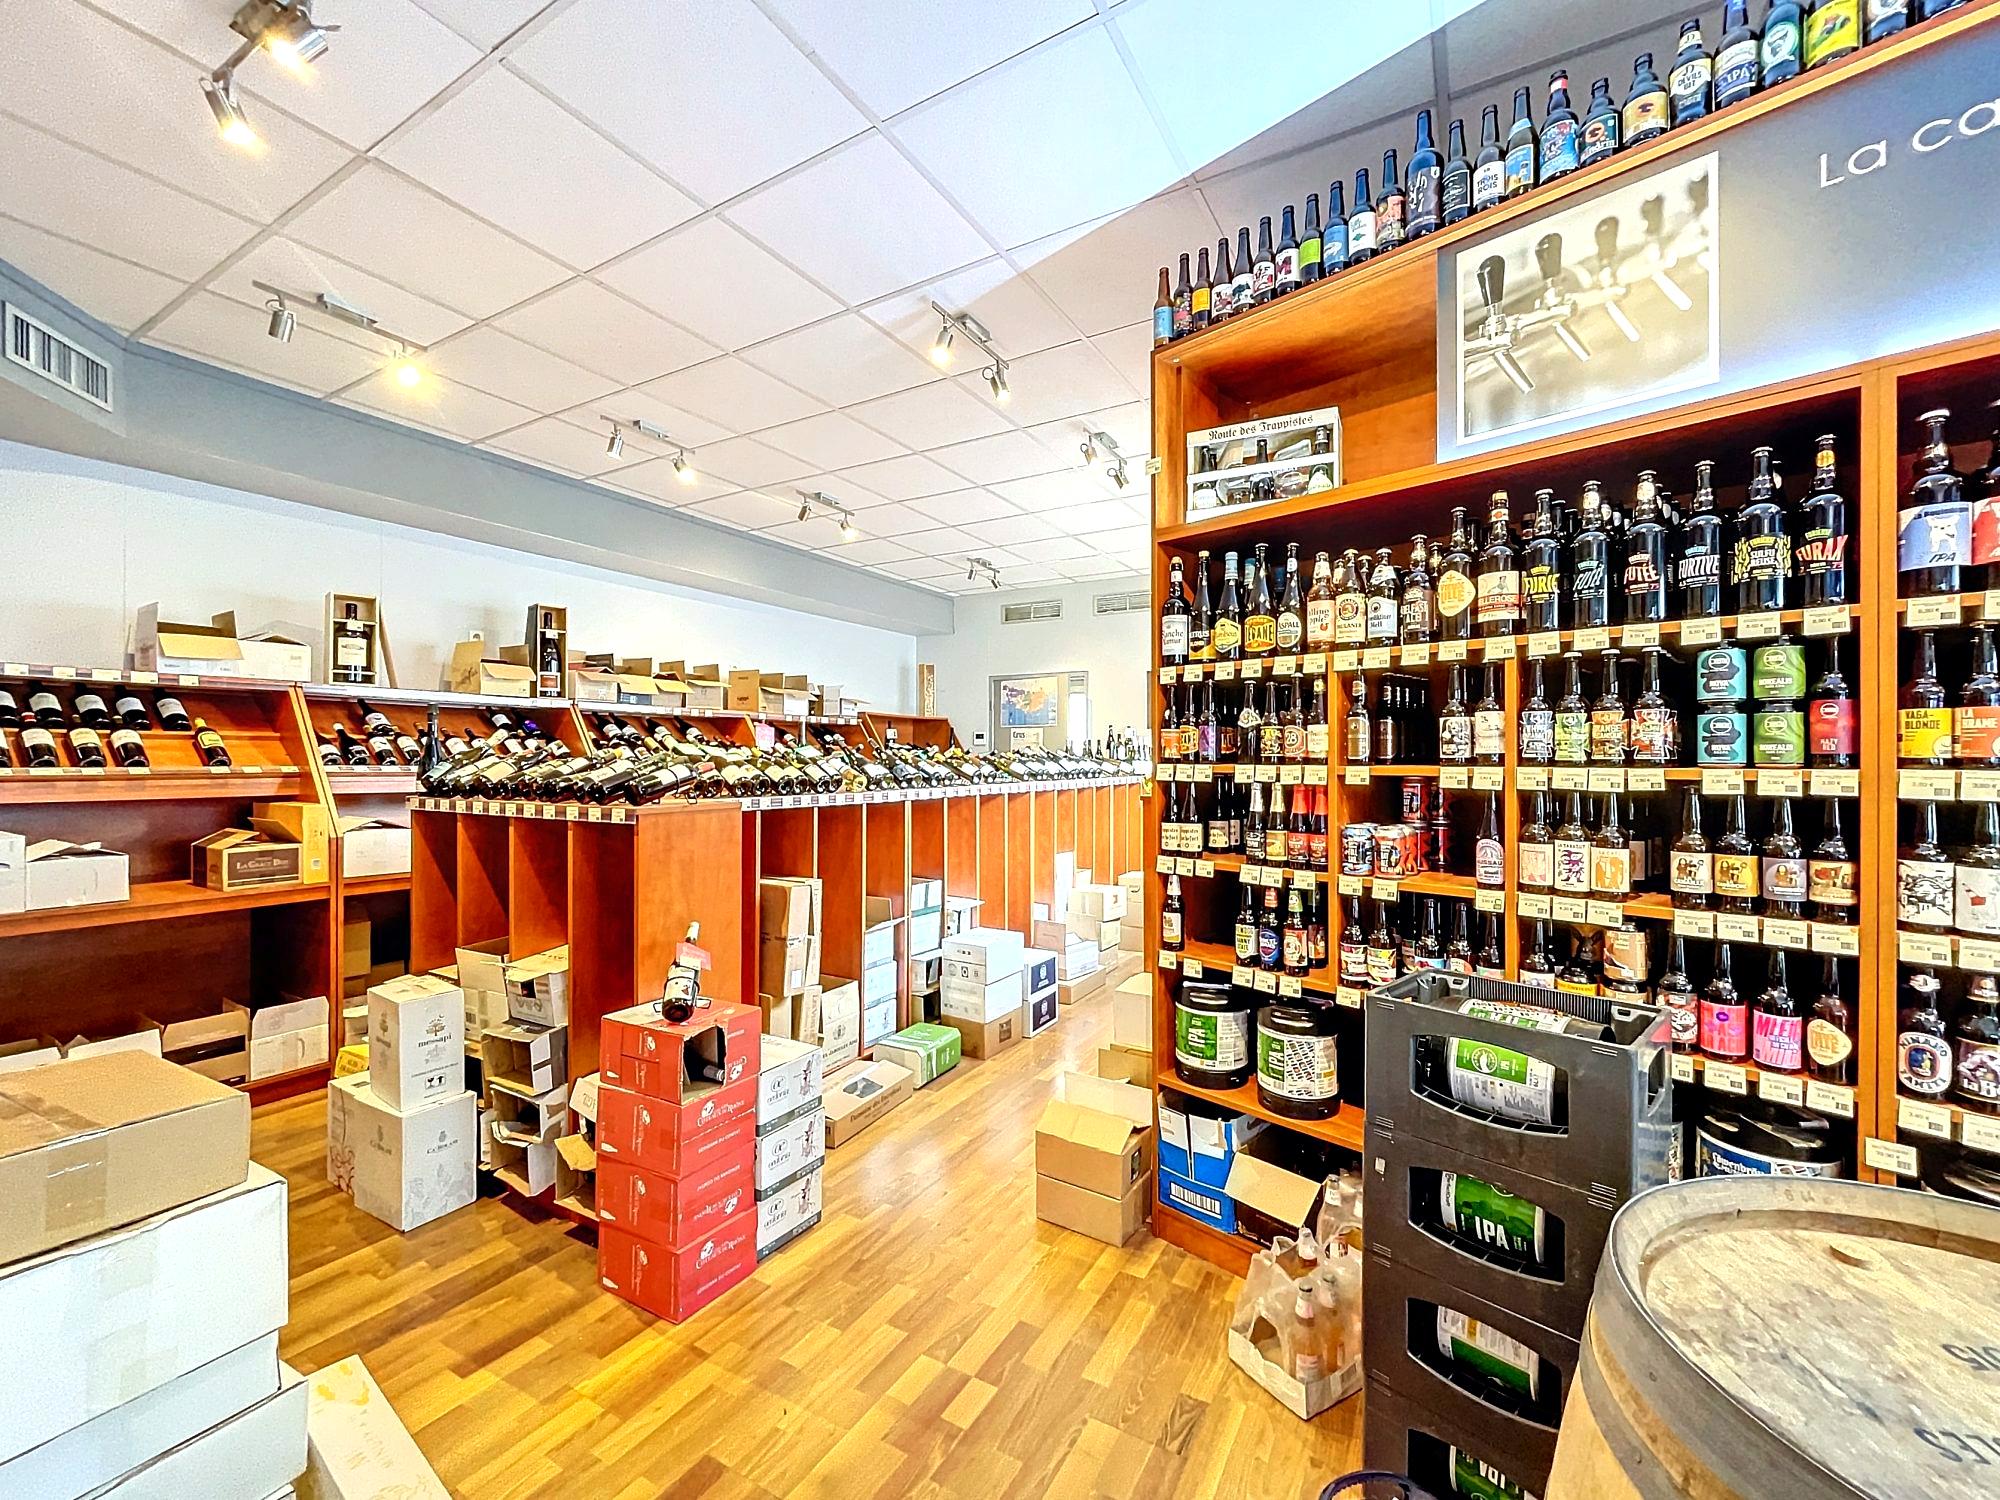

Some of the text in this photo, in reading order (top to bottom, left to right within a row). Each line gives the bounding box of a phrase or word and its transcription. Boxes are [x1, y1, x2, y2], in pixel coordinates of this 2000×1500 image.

[1678, 71, 1701, 86] DEVILS
[1727, 67, 1750, 82] IPA
[1684, 80, 1696, 90] BIT
[1819, 140, 1887, 188] La
[1477, 174, 1498, 187] TROIS
[1477, 182, 1497, 194] ROIS
[1209, 415, 1314, 441] Route des Trappistes
[1795, 535, 1848, 561] FURAX
[1679, 554, 1720, 579] FURTIVE
[1962, 709, 1975, 719] LA
[1905, 719, 1941, 730] BLONDE
[1980, 1080, 2000, 1098] B
[1475, 1216, 1509, 1250] IPA
